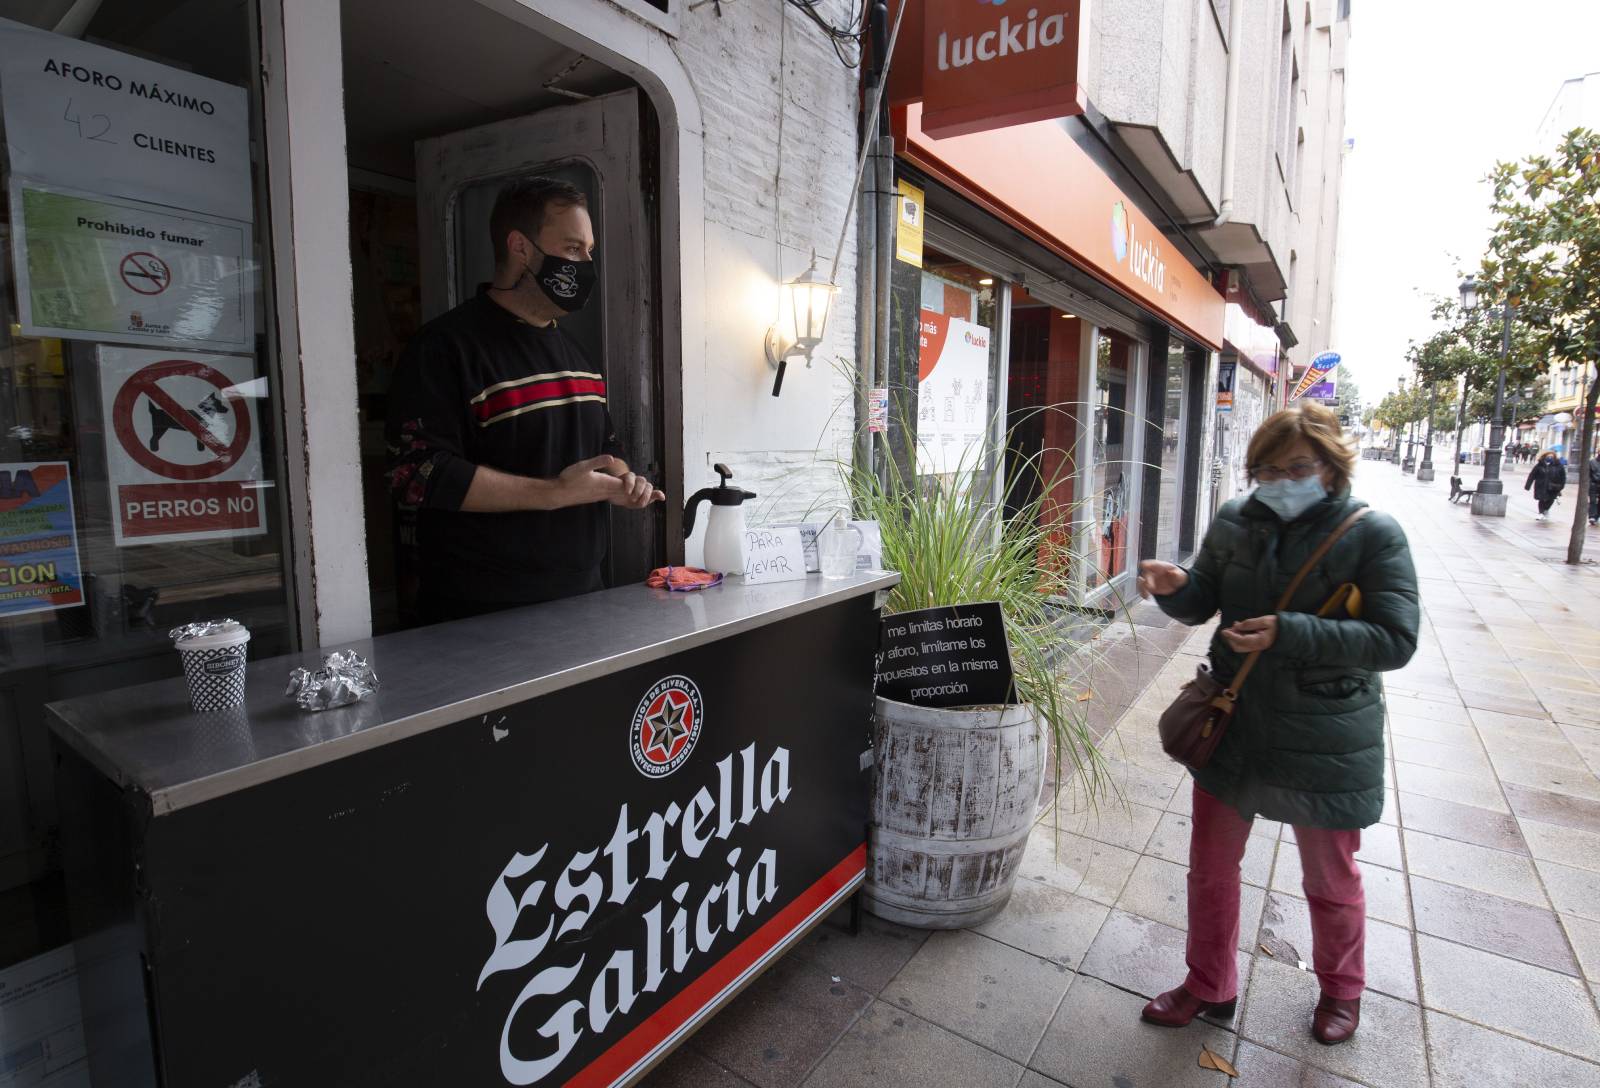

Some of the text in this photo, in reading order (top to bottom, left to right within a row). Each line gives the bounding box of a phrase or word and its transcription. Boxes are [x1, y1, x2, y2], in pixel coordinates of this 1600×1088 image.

[937, 9, 1064, 70] luckia
[44, 58, 215, 116] AFORO MÁXIMO
[64, 97, 118, 145] 42
[133, 133, 216, 164] CLIENTES
[77, 216, 204, 248] Prohibido fumar
[1129, 223, 1165, 294] luckia
[127, 496, 254, 521] PERROS NO
[746, 531, 783, 551] PARA
[888, 614, 982, 638] me limitas horario
[878, 637, 986, 664] y aforo, limítame los
[932, 664, 946, 674] en
[948, 661, 959, 673] la
[962, 659, 998, 671] misma
[634, 700, 650, 731] HIJOS
[649, 688, 660, 699] DE
[910, 682, 968, 700] proporción
[633, 718, 700, 774] CERVECEROS DESDE 1906
[476, 741, 792, 992] Estrella
[500, 847, 779, 1086] Galicia
